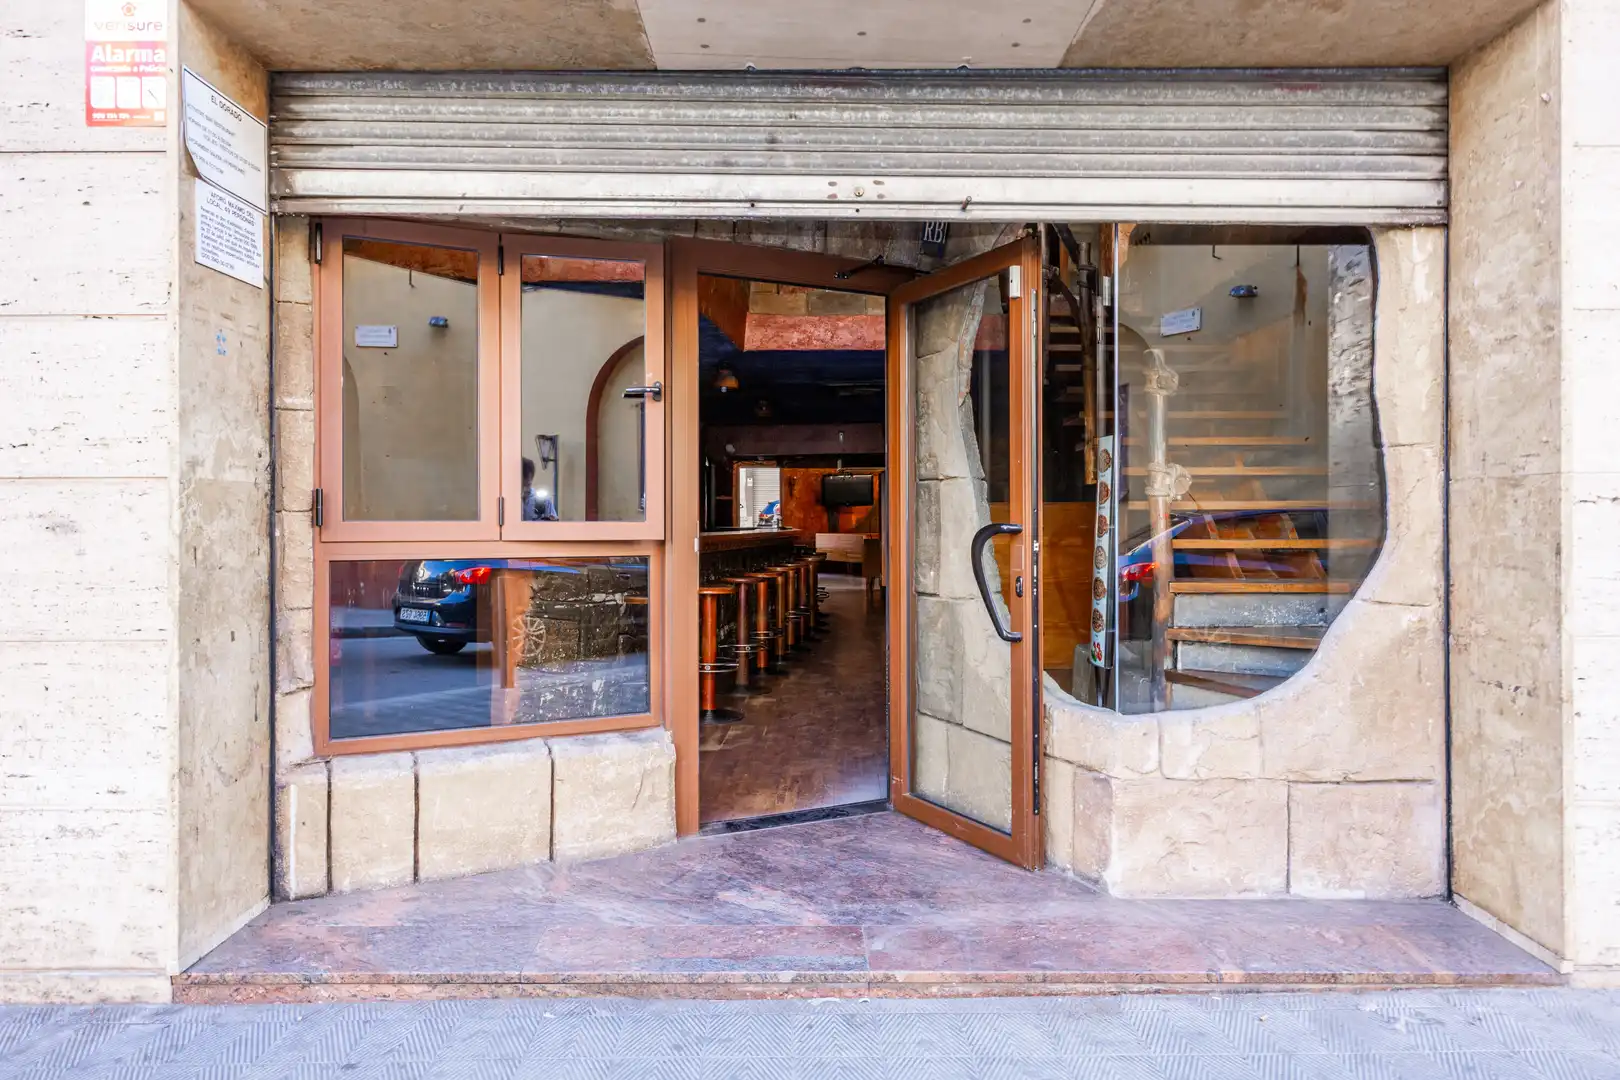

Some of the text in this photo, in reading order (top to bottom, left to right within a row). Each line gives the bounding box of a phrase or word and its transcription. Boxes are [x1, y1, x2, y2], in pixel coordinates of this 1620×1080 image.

[93, 21, 163, 31] verisure
[91, 44, 166, 62] Alarma
[210, 95, 218, 106] EL
[219, 101, 243, 122] DORADO
